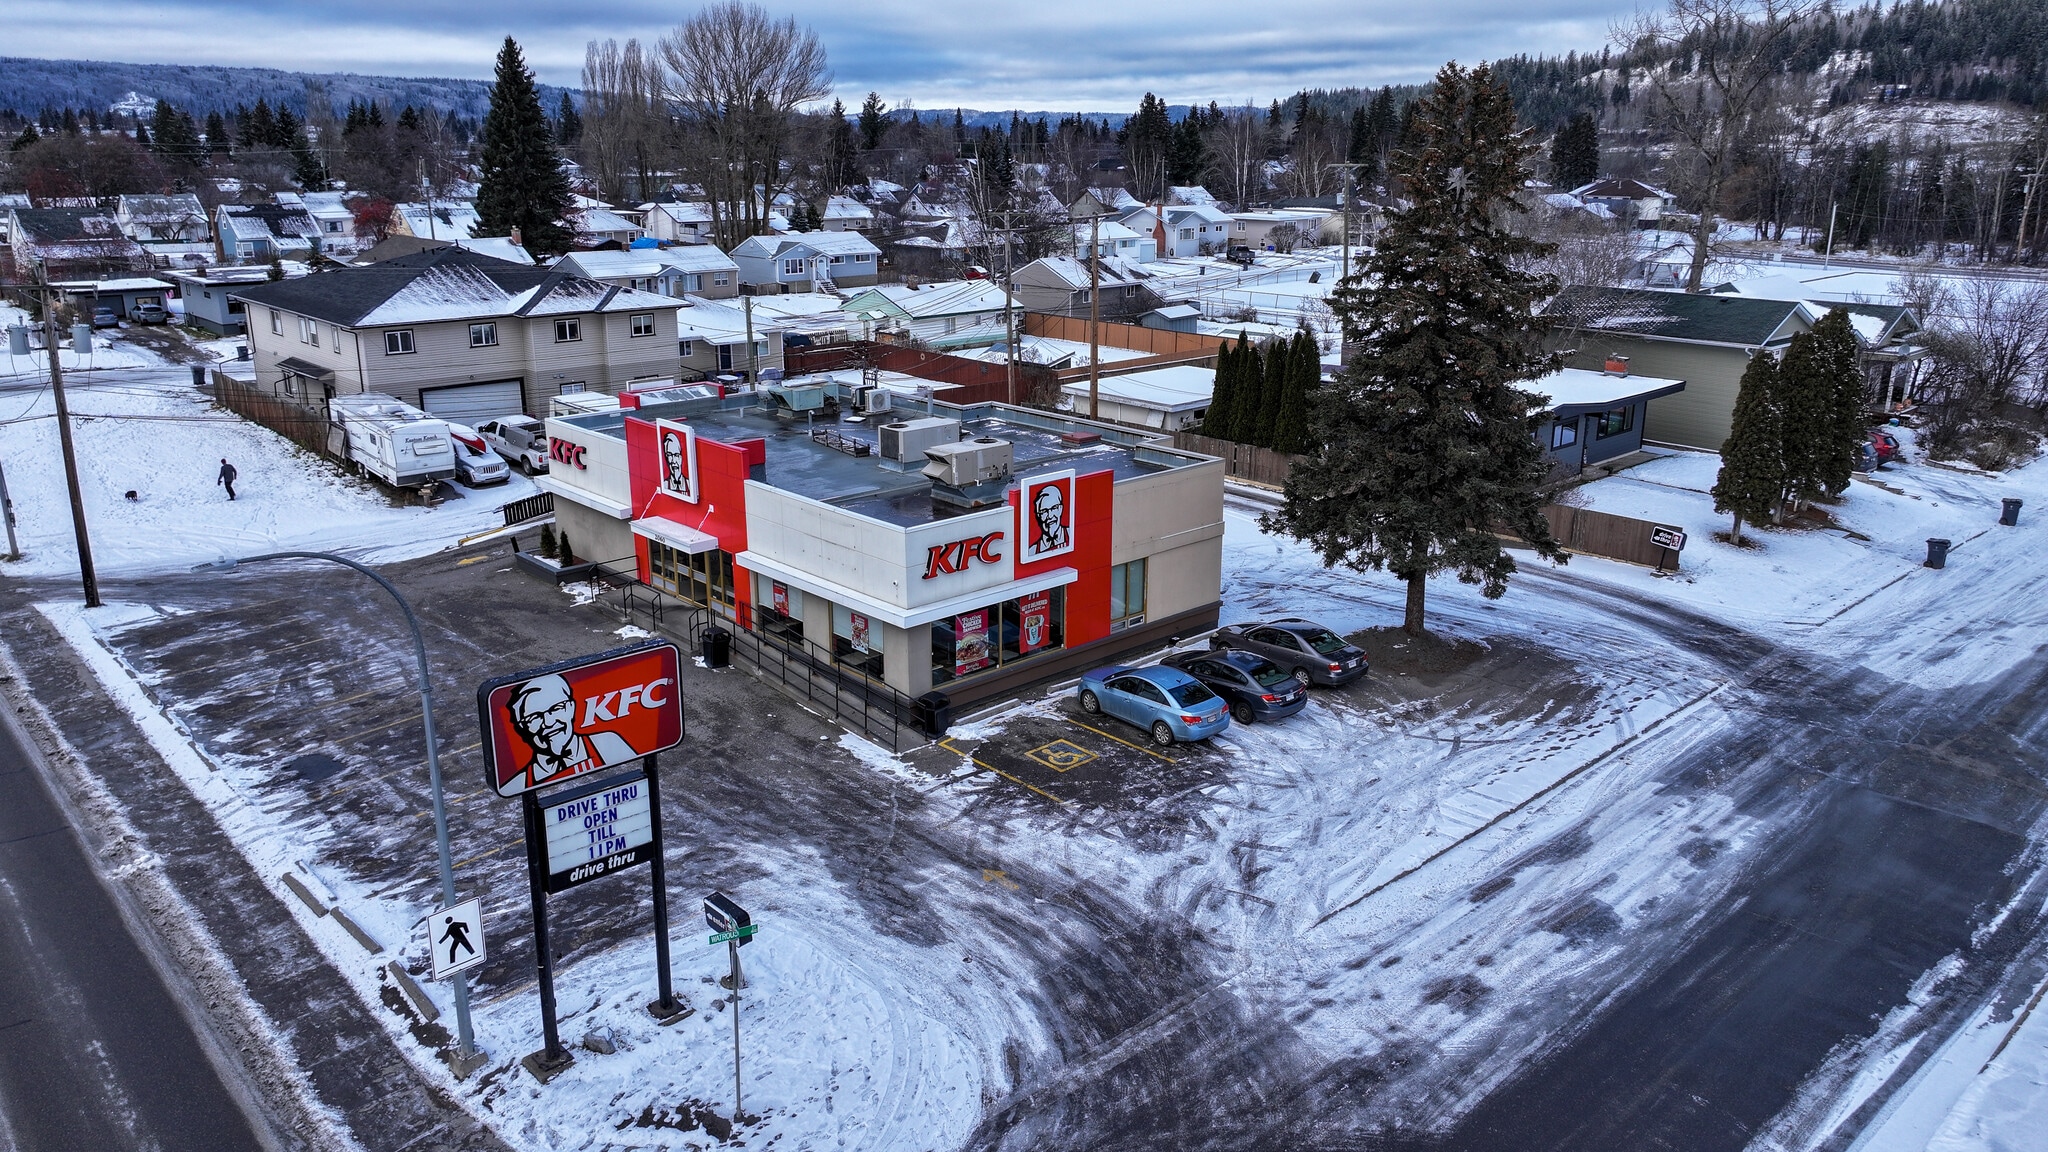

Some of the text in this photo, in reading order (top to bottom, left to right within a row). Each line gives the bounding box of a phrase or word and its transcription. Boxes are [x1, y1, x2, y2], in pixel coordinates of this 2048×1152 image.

[549, 436, 587, 470] KFC
[922, 531, 1004, 580] KFC
[581, 677, 669, 728] KFC
[557, 785, 638, 823] DRIVE THRU
[584, 807, 618, 829] OPEN
[588, 826, 616, 844] TILL
[569, 850, 636, 882] drive thru
